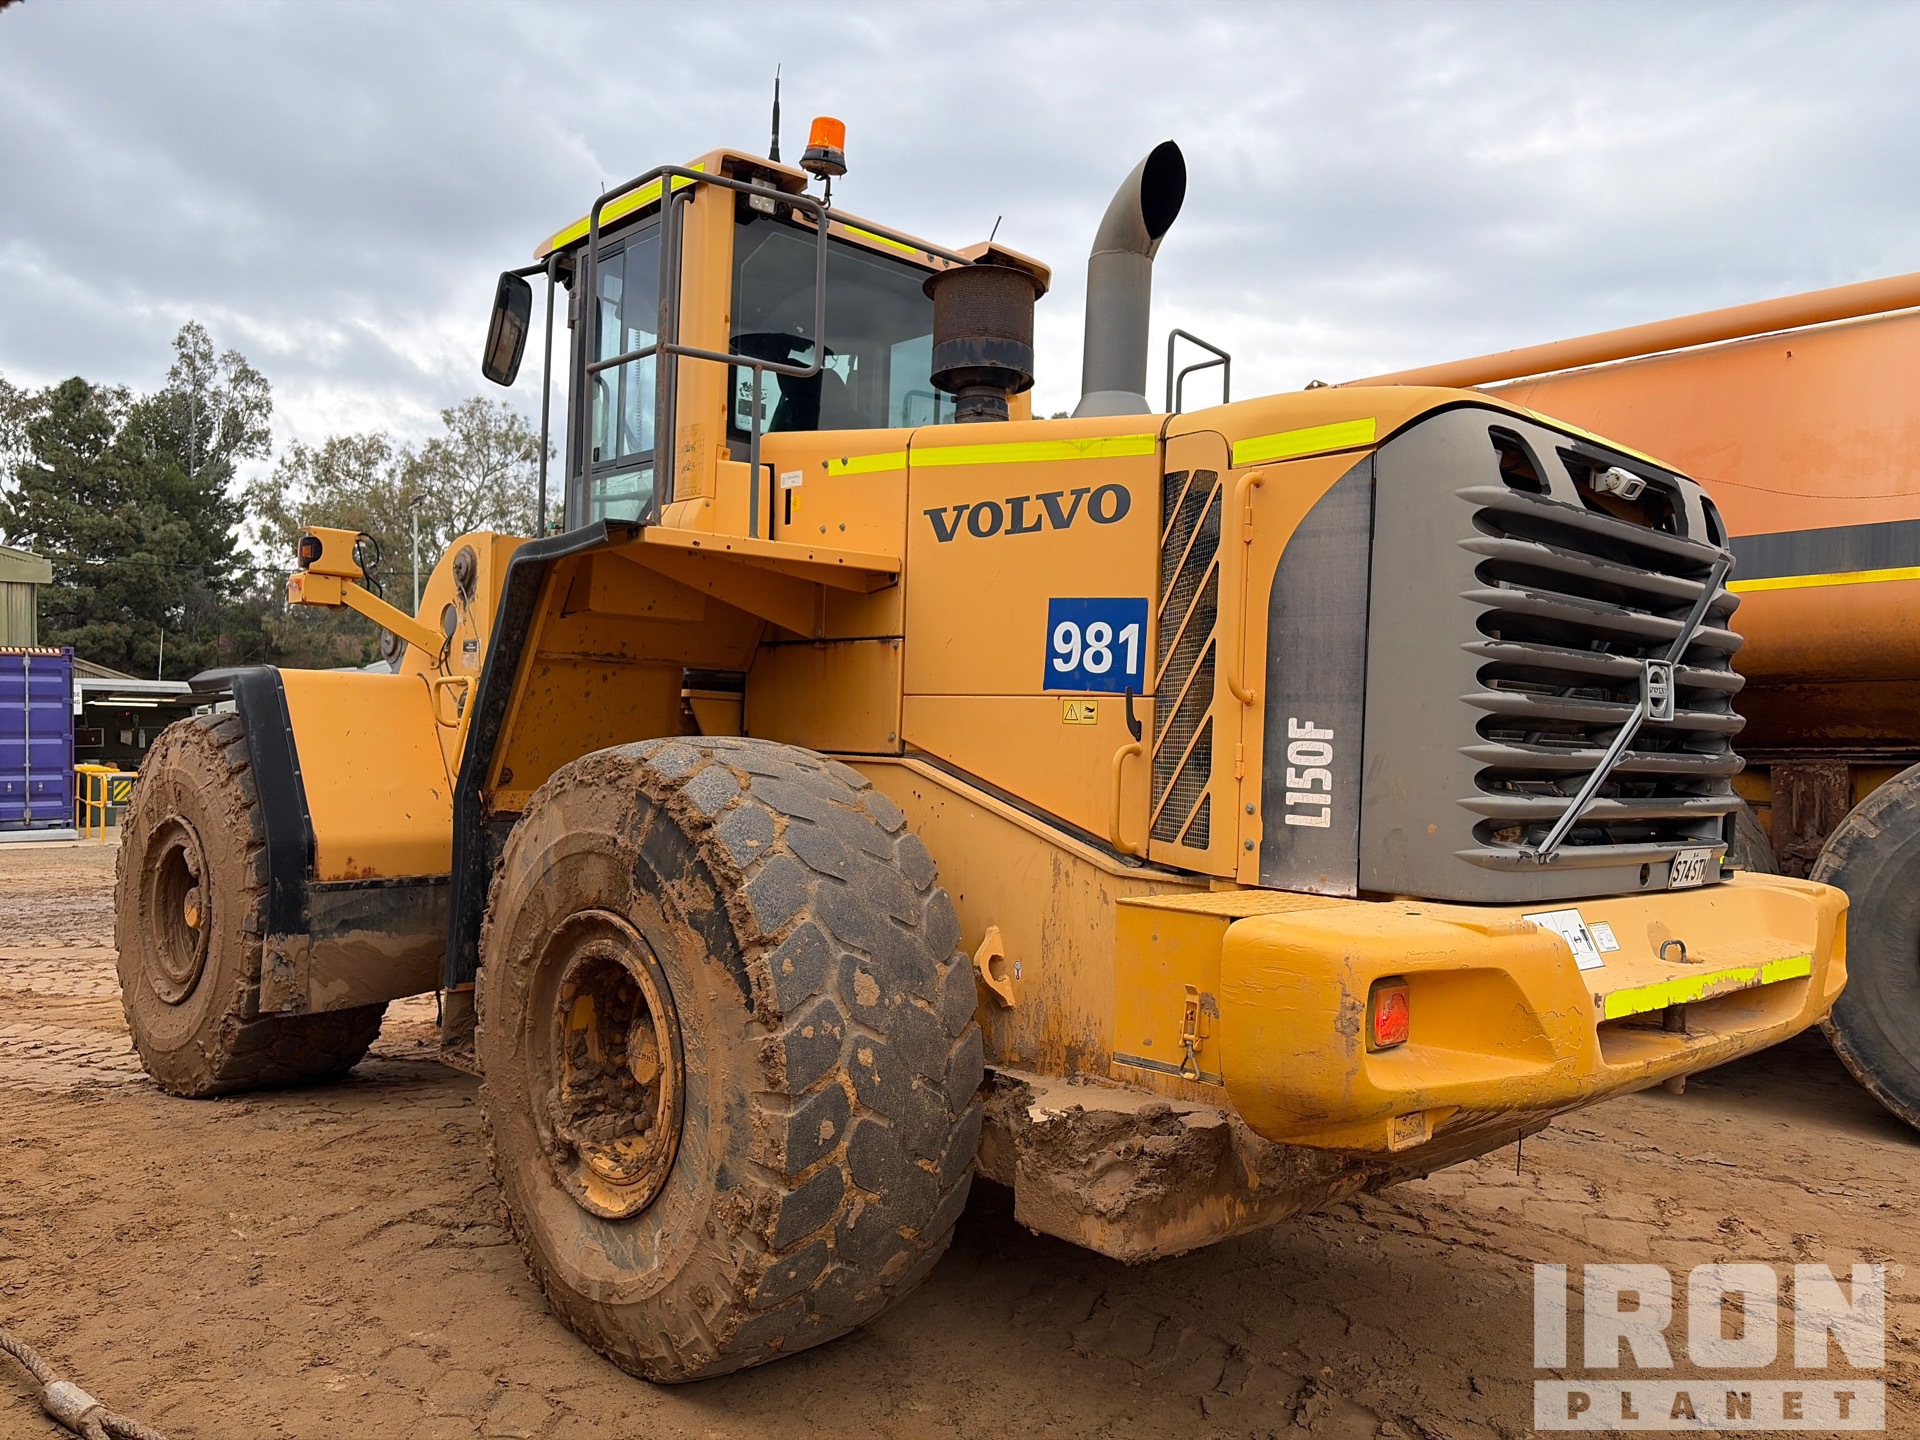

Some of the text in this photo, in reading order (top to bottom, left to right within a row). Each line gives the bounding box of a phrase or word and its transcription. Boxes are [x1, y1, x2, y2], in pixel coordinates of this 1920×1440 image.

[923, 483, 1131, 543] VOLVO
[1053, 621, 1139, 675] 981
[1285, 717, 1334, 828] L150F
